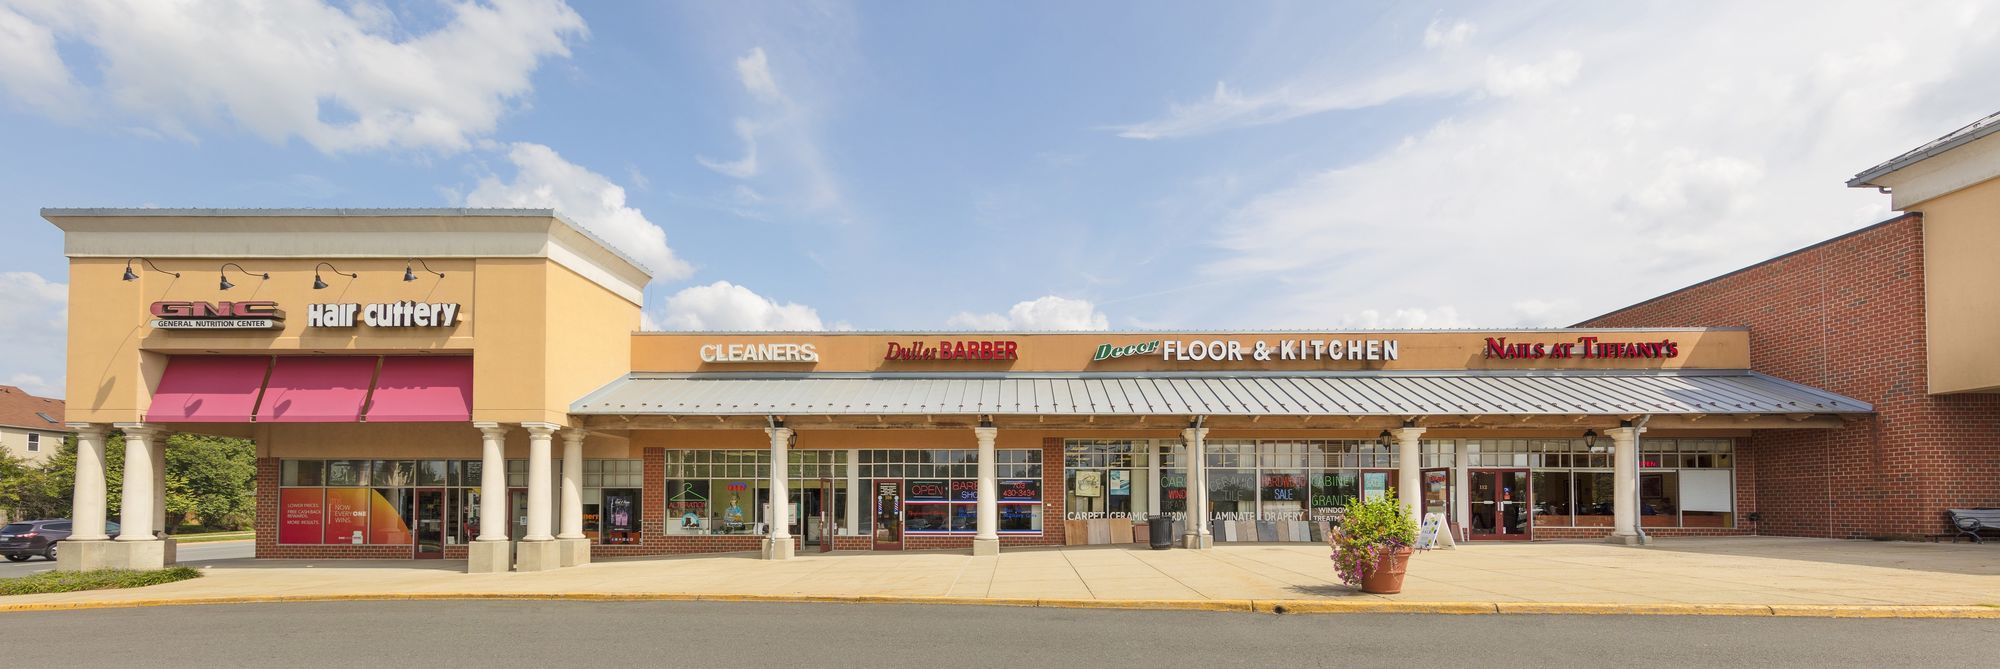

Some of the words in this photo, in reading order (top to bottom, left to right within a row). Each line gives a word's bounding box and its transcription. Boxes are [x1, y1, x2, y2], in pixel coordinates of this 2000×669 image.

[150, 301, 284, 319] GNC
[308, 303, 360, 327] Hair
[158, 320, 193, 328] GENERAL
[195, 320, 234, 328] NUTRITION
[236, 320, 266, 328] CENTER
[700, 343, 819, 362] CLEANERS
[884, 341, 938, 361] Dulles
[940, 340, 1018, 361] BARBER
[1094, 339, 1160, 360] Decor
[1162, 339, 1243, 361] FLOOR
[1253, 340, 1272, 361] &
[1279, 339, 1398, 361] KITCHEN
[1160, 476, 1187, 488] CAR
[1311, 475, 1356, 488] CABINET
[911, 485, 944, 496] OPEN
[1003, 489, 1036, 497] 430-3434
[1274, 488, 1294, 500] SALE
[1067, 511, 1105, 520] CARPET
[1109, 511, 1148, 520] CERAMIC
[1209, 511, 1255, 521] LAMINATE
[1264, 511, 1304, 521] DRAPERY
